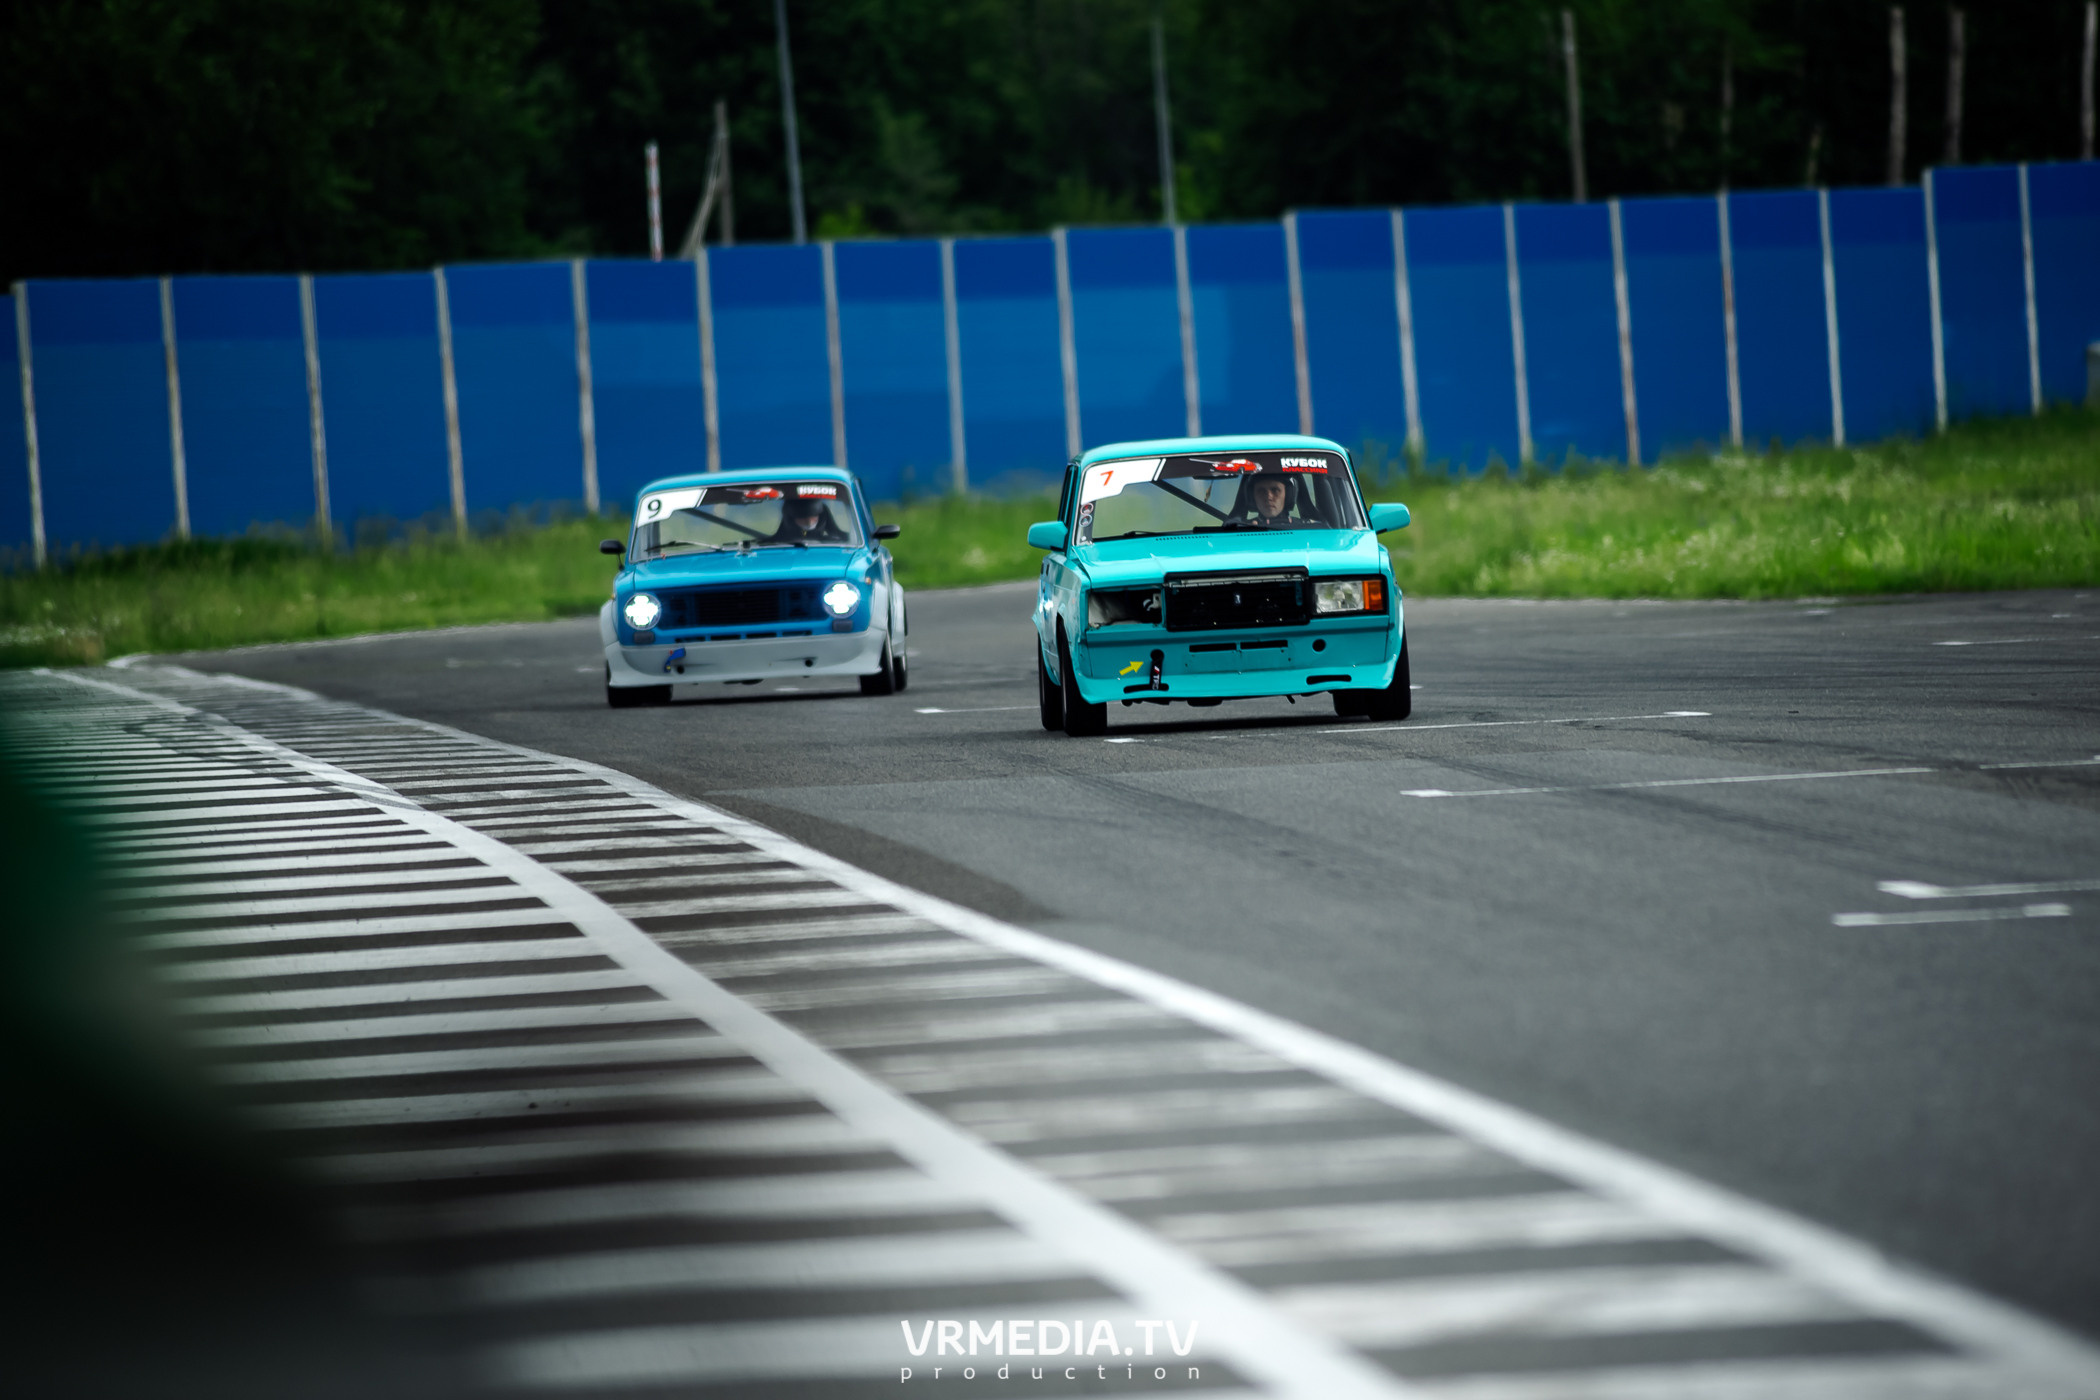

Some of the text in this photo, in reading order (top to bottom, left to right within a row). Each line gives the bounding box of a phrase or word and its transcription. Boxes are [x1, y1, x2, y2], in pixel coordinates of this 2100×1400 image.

[1280, 458, 1328, 468] КУБОК
[1100, 470, 1114, 487] 7
[648, 499, 662, 519] 9
